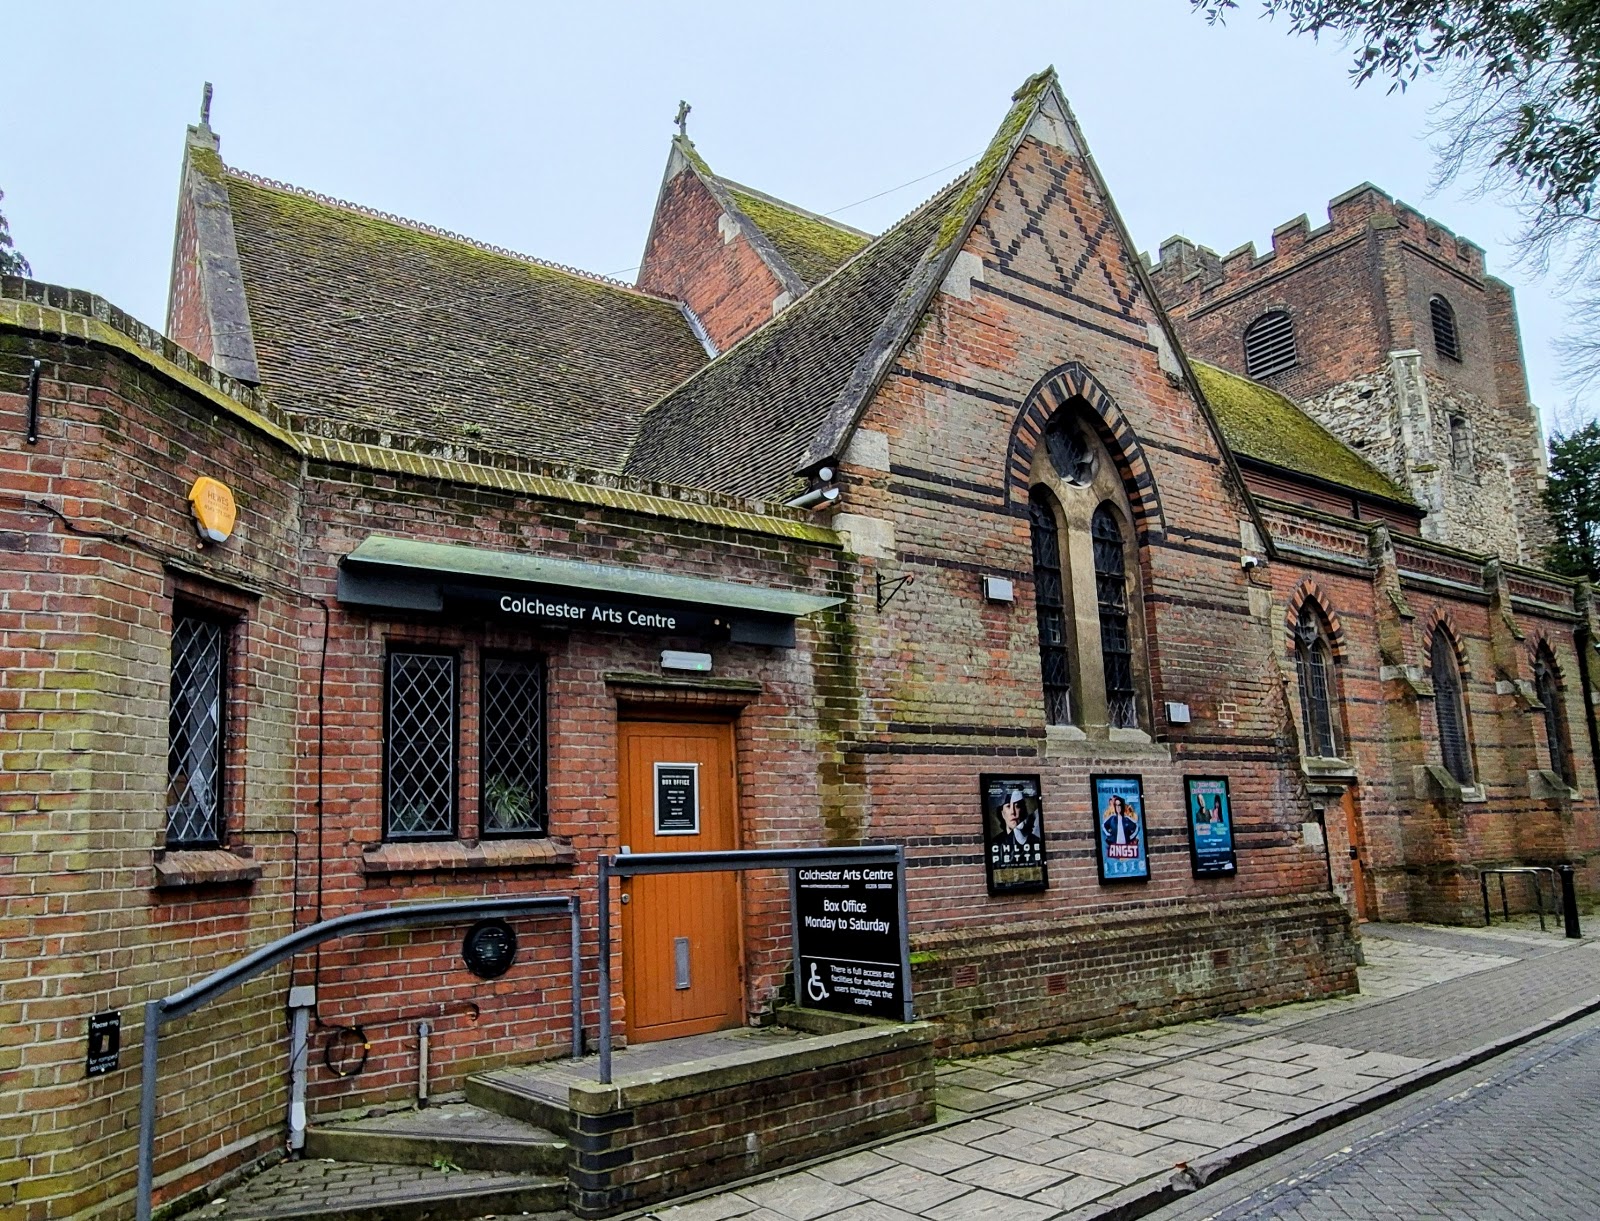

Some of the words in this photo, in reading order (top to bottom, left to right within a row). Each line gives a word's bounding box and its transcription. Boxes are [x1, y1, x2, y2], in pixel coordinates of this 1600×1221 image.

[500, 596, 586, 619] Colchester
[592, 606, 623, 624] Arts
[628, 610, 676, 629] Centre
[991, 843, 1040, 853] CHLOE
[1109, 845, 1138, 857] ANGST
[992, 853, 1041, 863] PETTS
[799, 869, 841, 880] Colchester
[843, 869, 861, 880] Arts
[863, 869, 894, 880] Centre
[824, 899, 840, 912] Box
[841, 900, 867, 913] Office
[805, 915, 836, 931] Monday
[838, 917, 847, 929] to
[849, 917, 890, 935] Saturday
[830, 965, 846, 973] There
[853, 967, 862, 975] full
[863, 970, 882, 978] access
[883, 971, 895, 979] and
[831, 974, 853, 984] facilities
[854, 977, 863, 985] for
[863, 979, 895, 988] wheelchair
[850, 987, 881, 997] throughout
[882, 991, 893, 999] the
[854, 998, 872, 1006] centre
